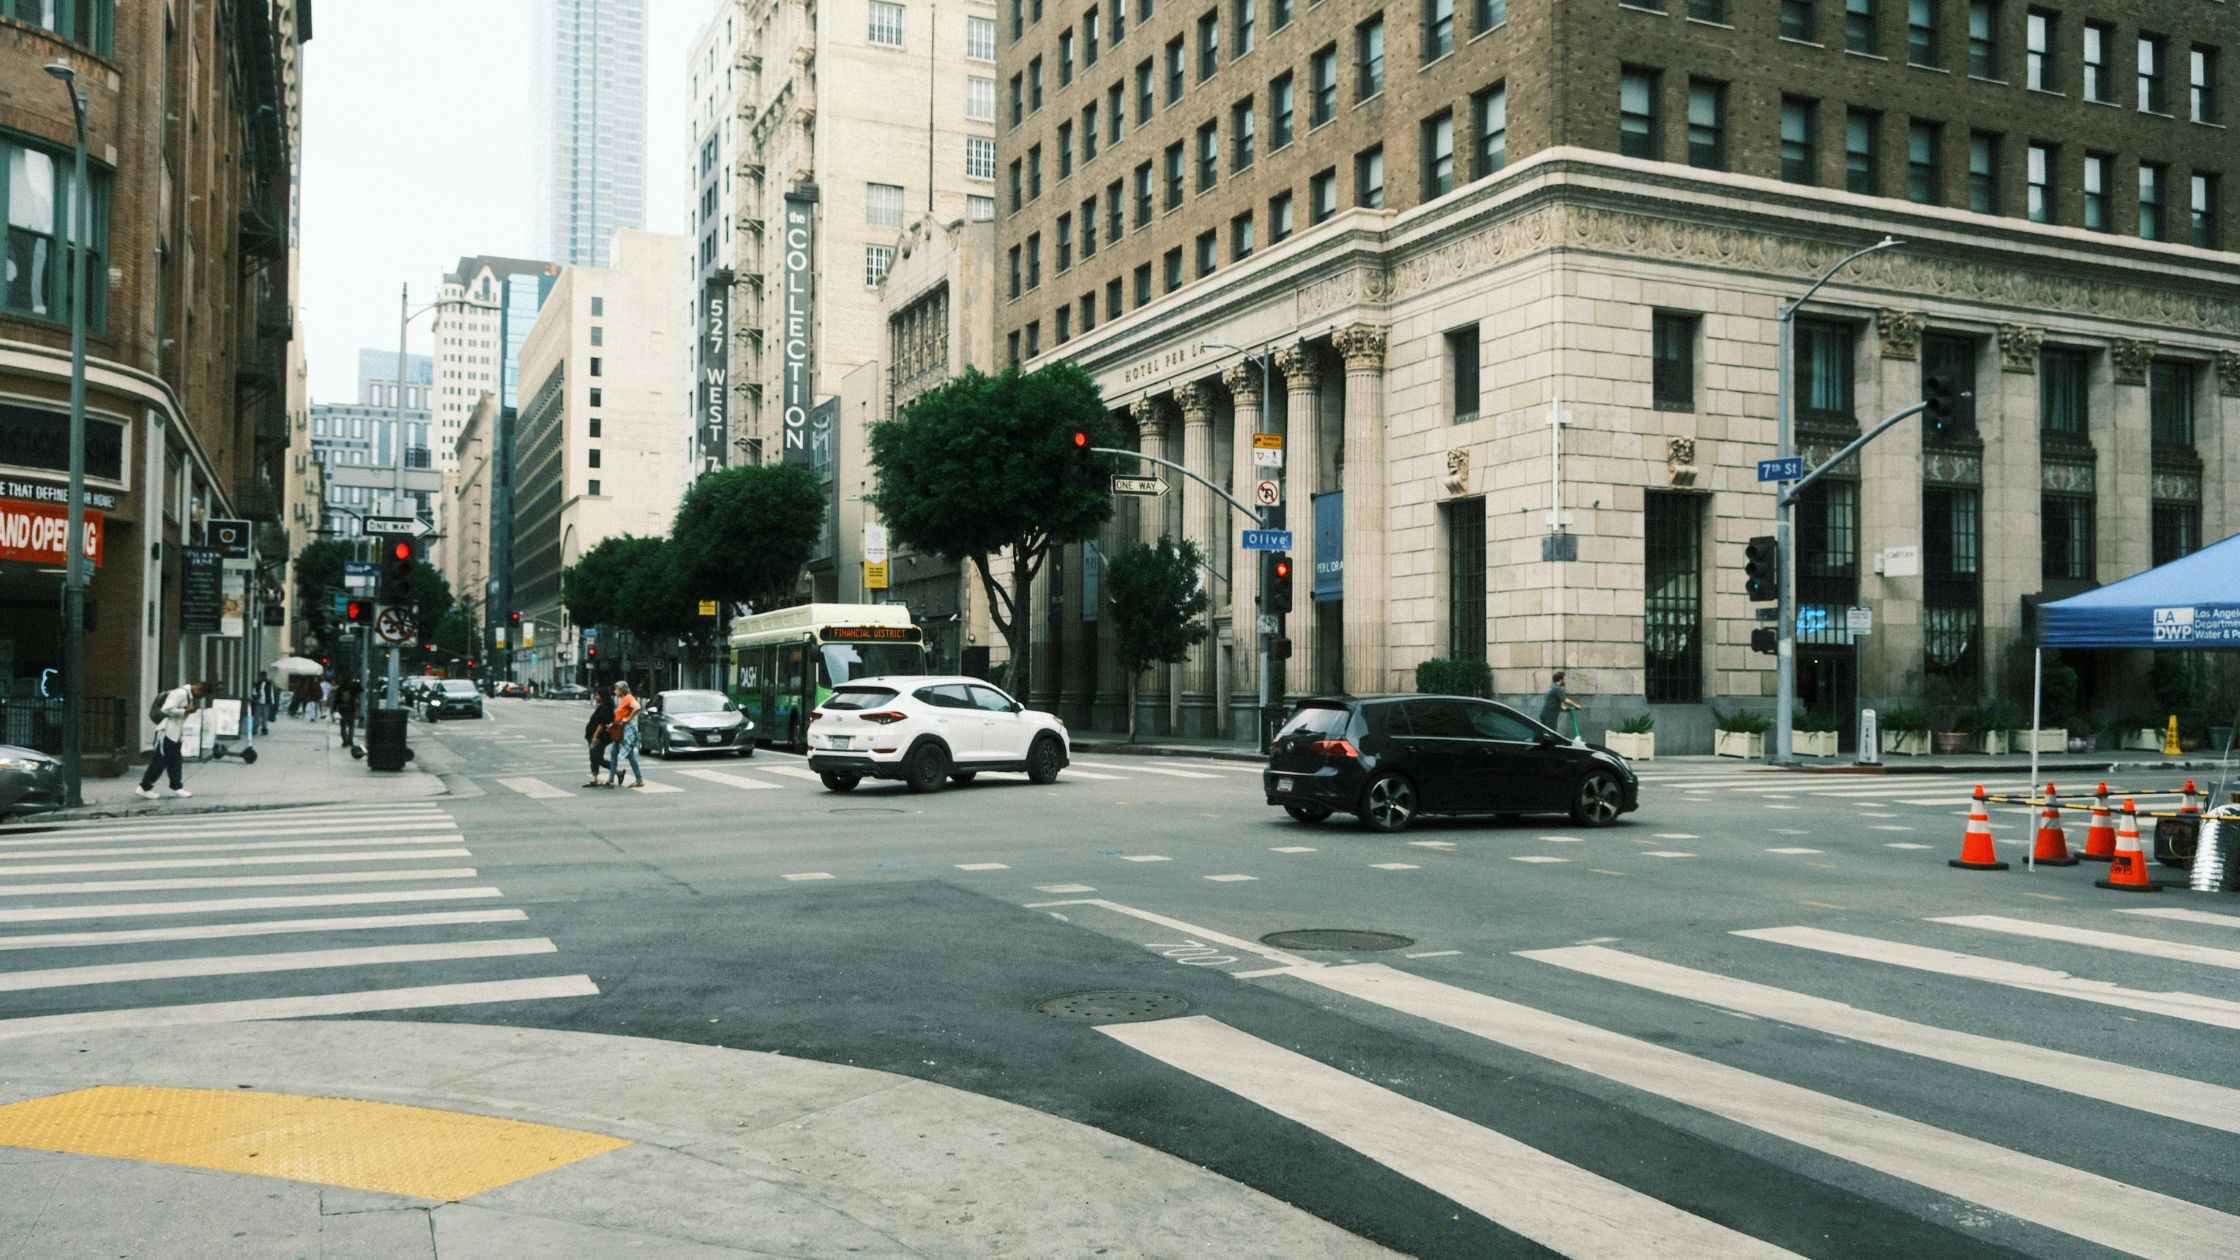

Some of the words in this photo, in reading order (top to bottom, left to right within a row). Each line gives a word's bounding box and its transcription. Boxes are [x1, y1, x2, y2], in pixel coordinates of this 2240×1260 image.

[789, 211, 806, 224] the
[710, 299, 724, 354] 527
[785, 228, 808, 450] COLLECTION
[1125, 360, 1159, 383] HOTEL
[1165, 350, 1185, 367] PER
[706, 368, 726, 442] WEST
[1762, 463, 1781, 479] 7th
[1784, 462, 1798, 476] St
[1116, 480, 1134, 490] ONE
[1139, 482, 1156, 491] WAY
[8, 482, 34, 500] THAT
[35, 485, 69, 504] DEFINE
[368, 520, 389, 532] ONE
[392, 523, 412, 532] WAY
[1248, 533, 1287, 545] Olive
[2156, 610, 2176, 624] LA
[2195, 608, 2211, 619] Los
[2212, 608, 2240, 619] Angel
[834, 628, 871, 638] FINANCIAL
[873, 629, 906, 638] DISTRICT
[2155, 626, 2192, 640] DWP
[2195, 630, 2222, 640] Water
[2223, 629, 2231, 640] &
[740, 666, 758, 688] DASH
